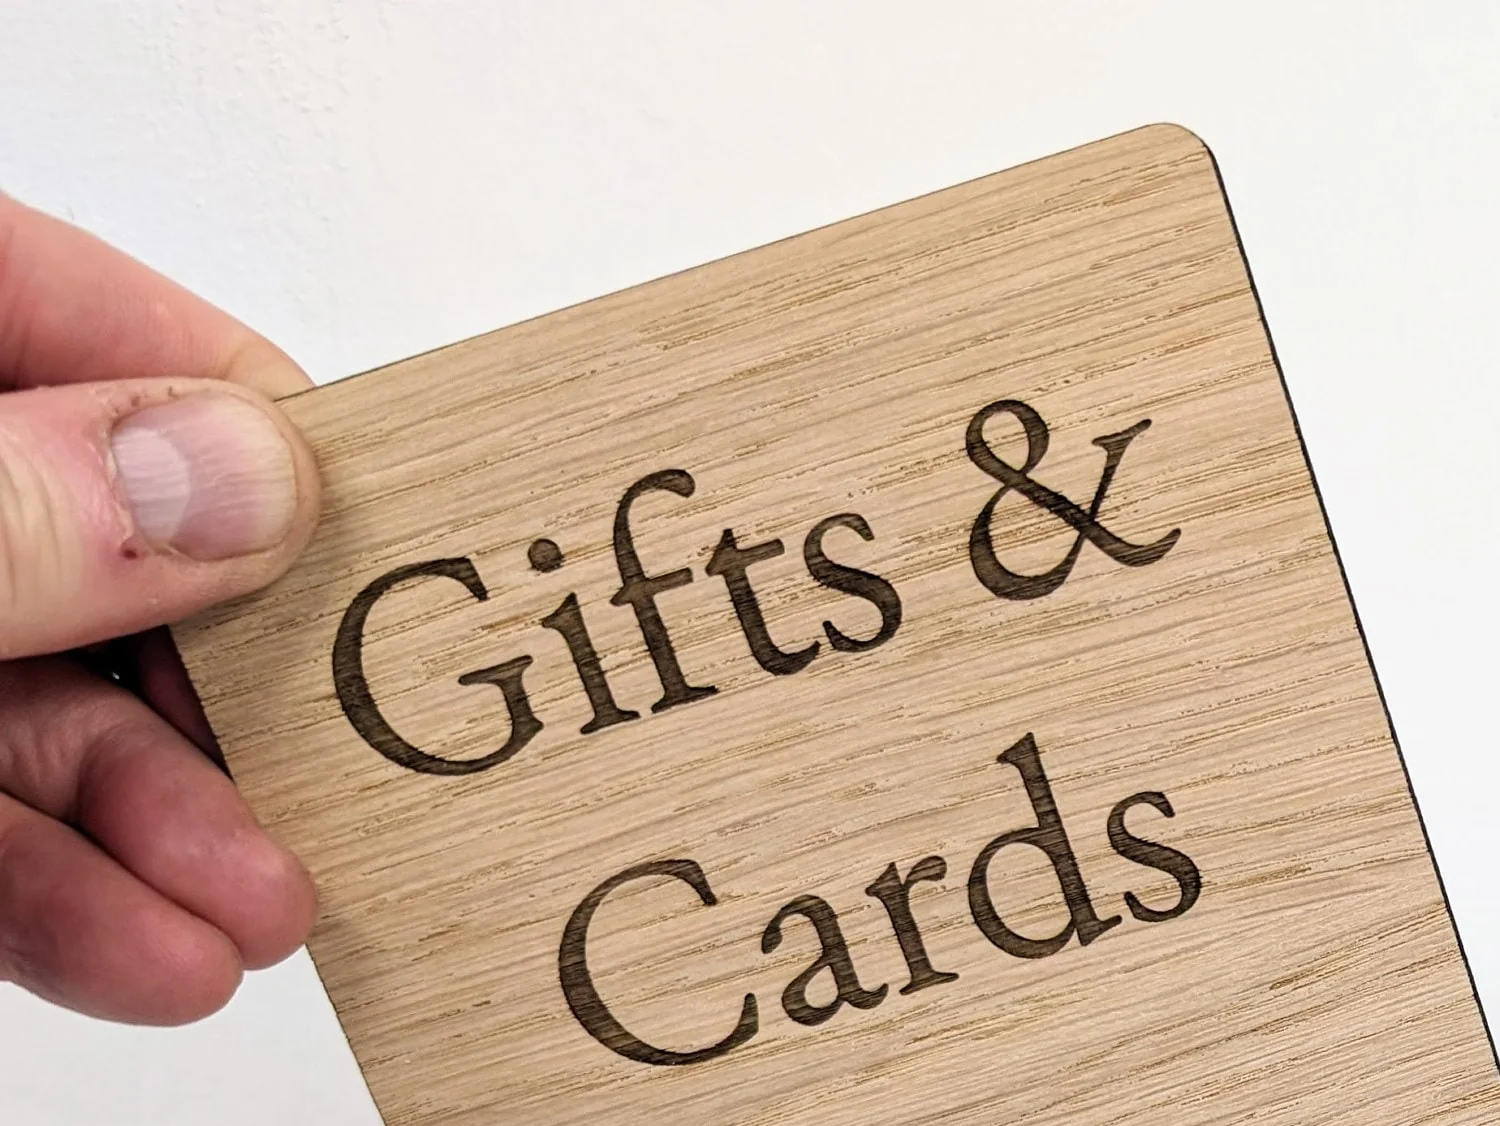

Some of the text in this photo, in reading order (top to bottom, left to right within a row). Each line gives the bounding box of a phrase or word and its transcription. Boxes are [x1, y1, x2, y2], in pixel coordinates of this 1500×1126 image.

[330, 398, 1183, 777] Gifts &
[557, 731, 1206, 1067] Cards
